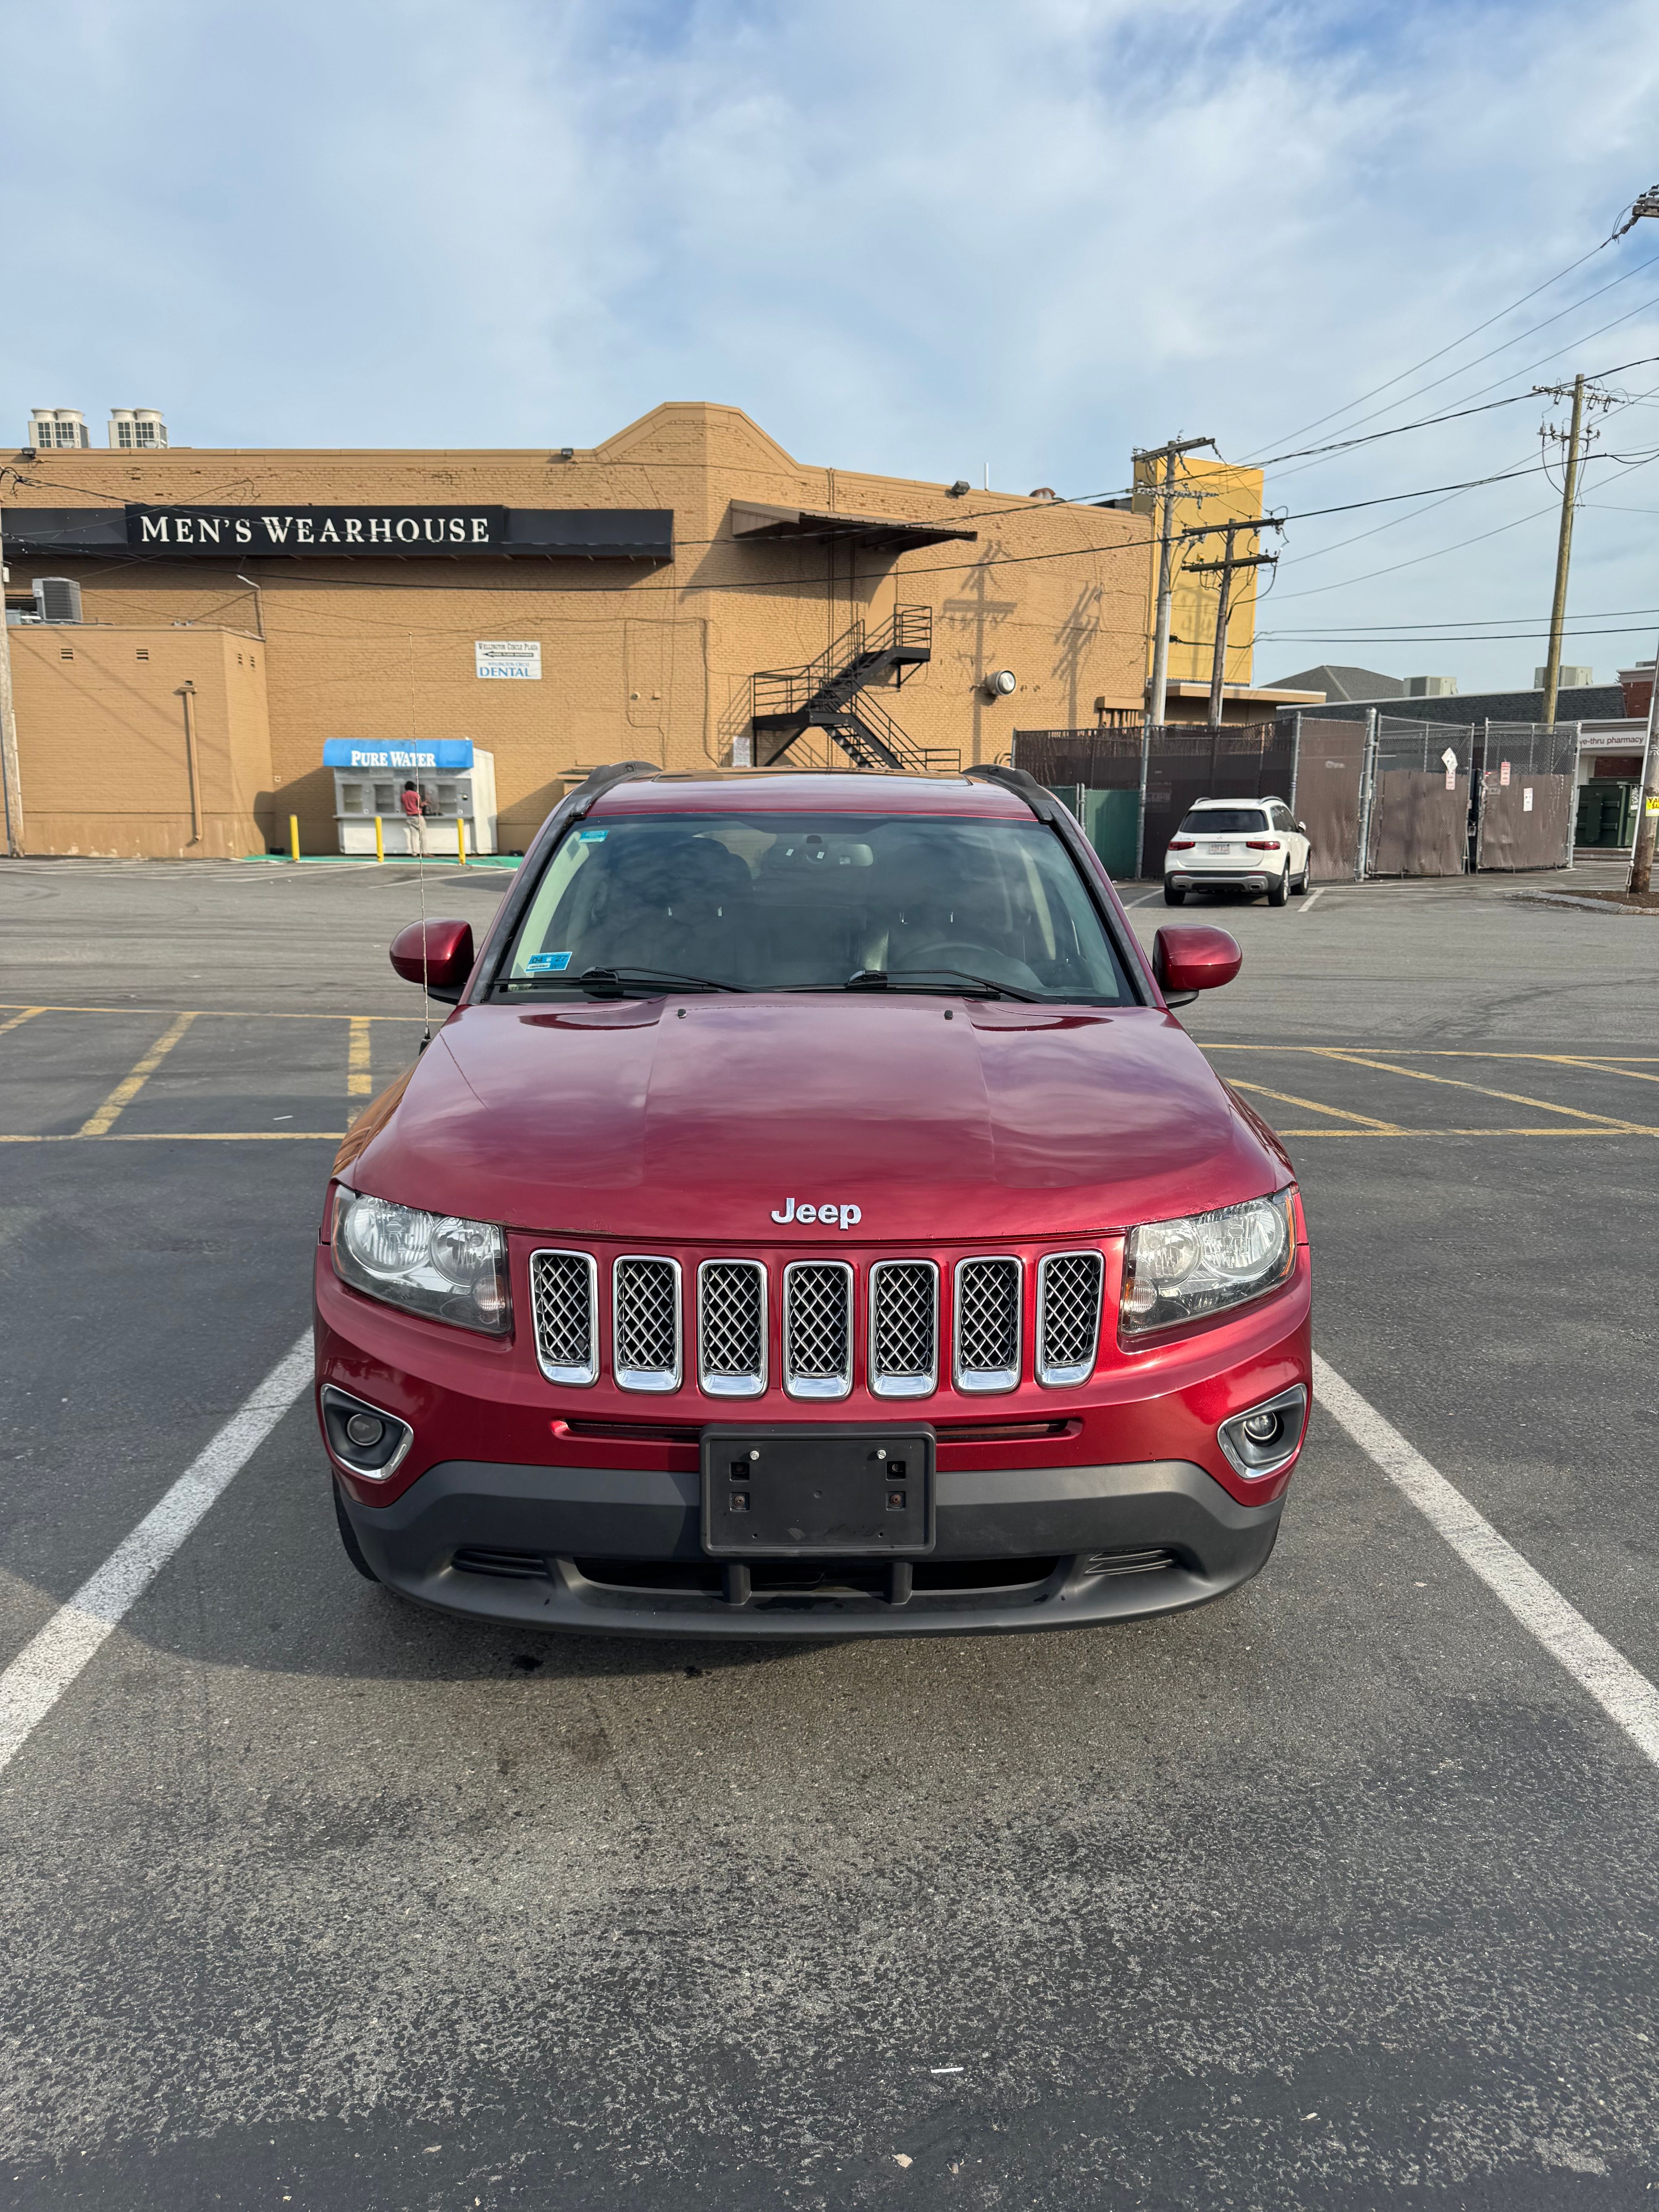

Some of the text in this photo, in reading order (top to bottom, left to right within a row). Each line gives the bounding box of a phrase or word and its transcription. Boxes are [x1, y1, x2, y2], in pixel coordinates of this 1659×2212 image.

[141, 516, 489, 543] MEN'S WEARHOUSE
[480, 667, 531, 677] DENTAL
[1607, 737, 1644, 745] pharmacy
[351, 750, 436, 767] PURE WATER
[771, 1197, 862, 1231] Jeep
